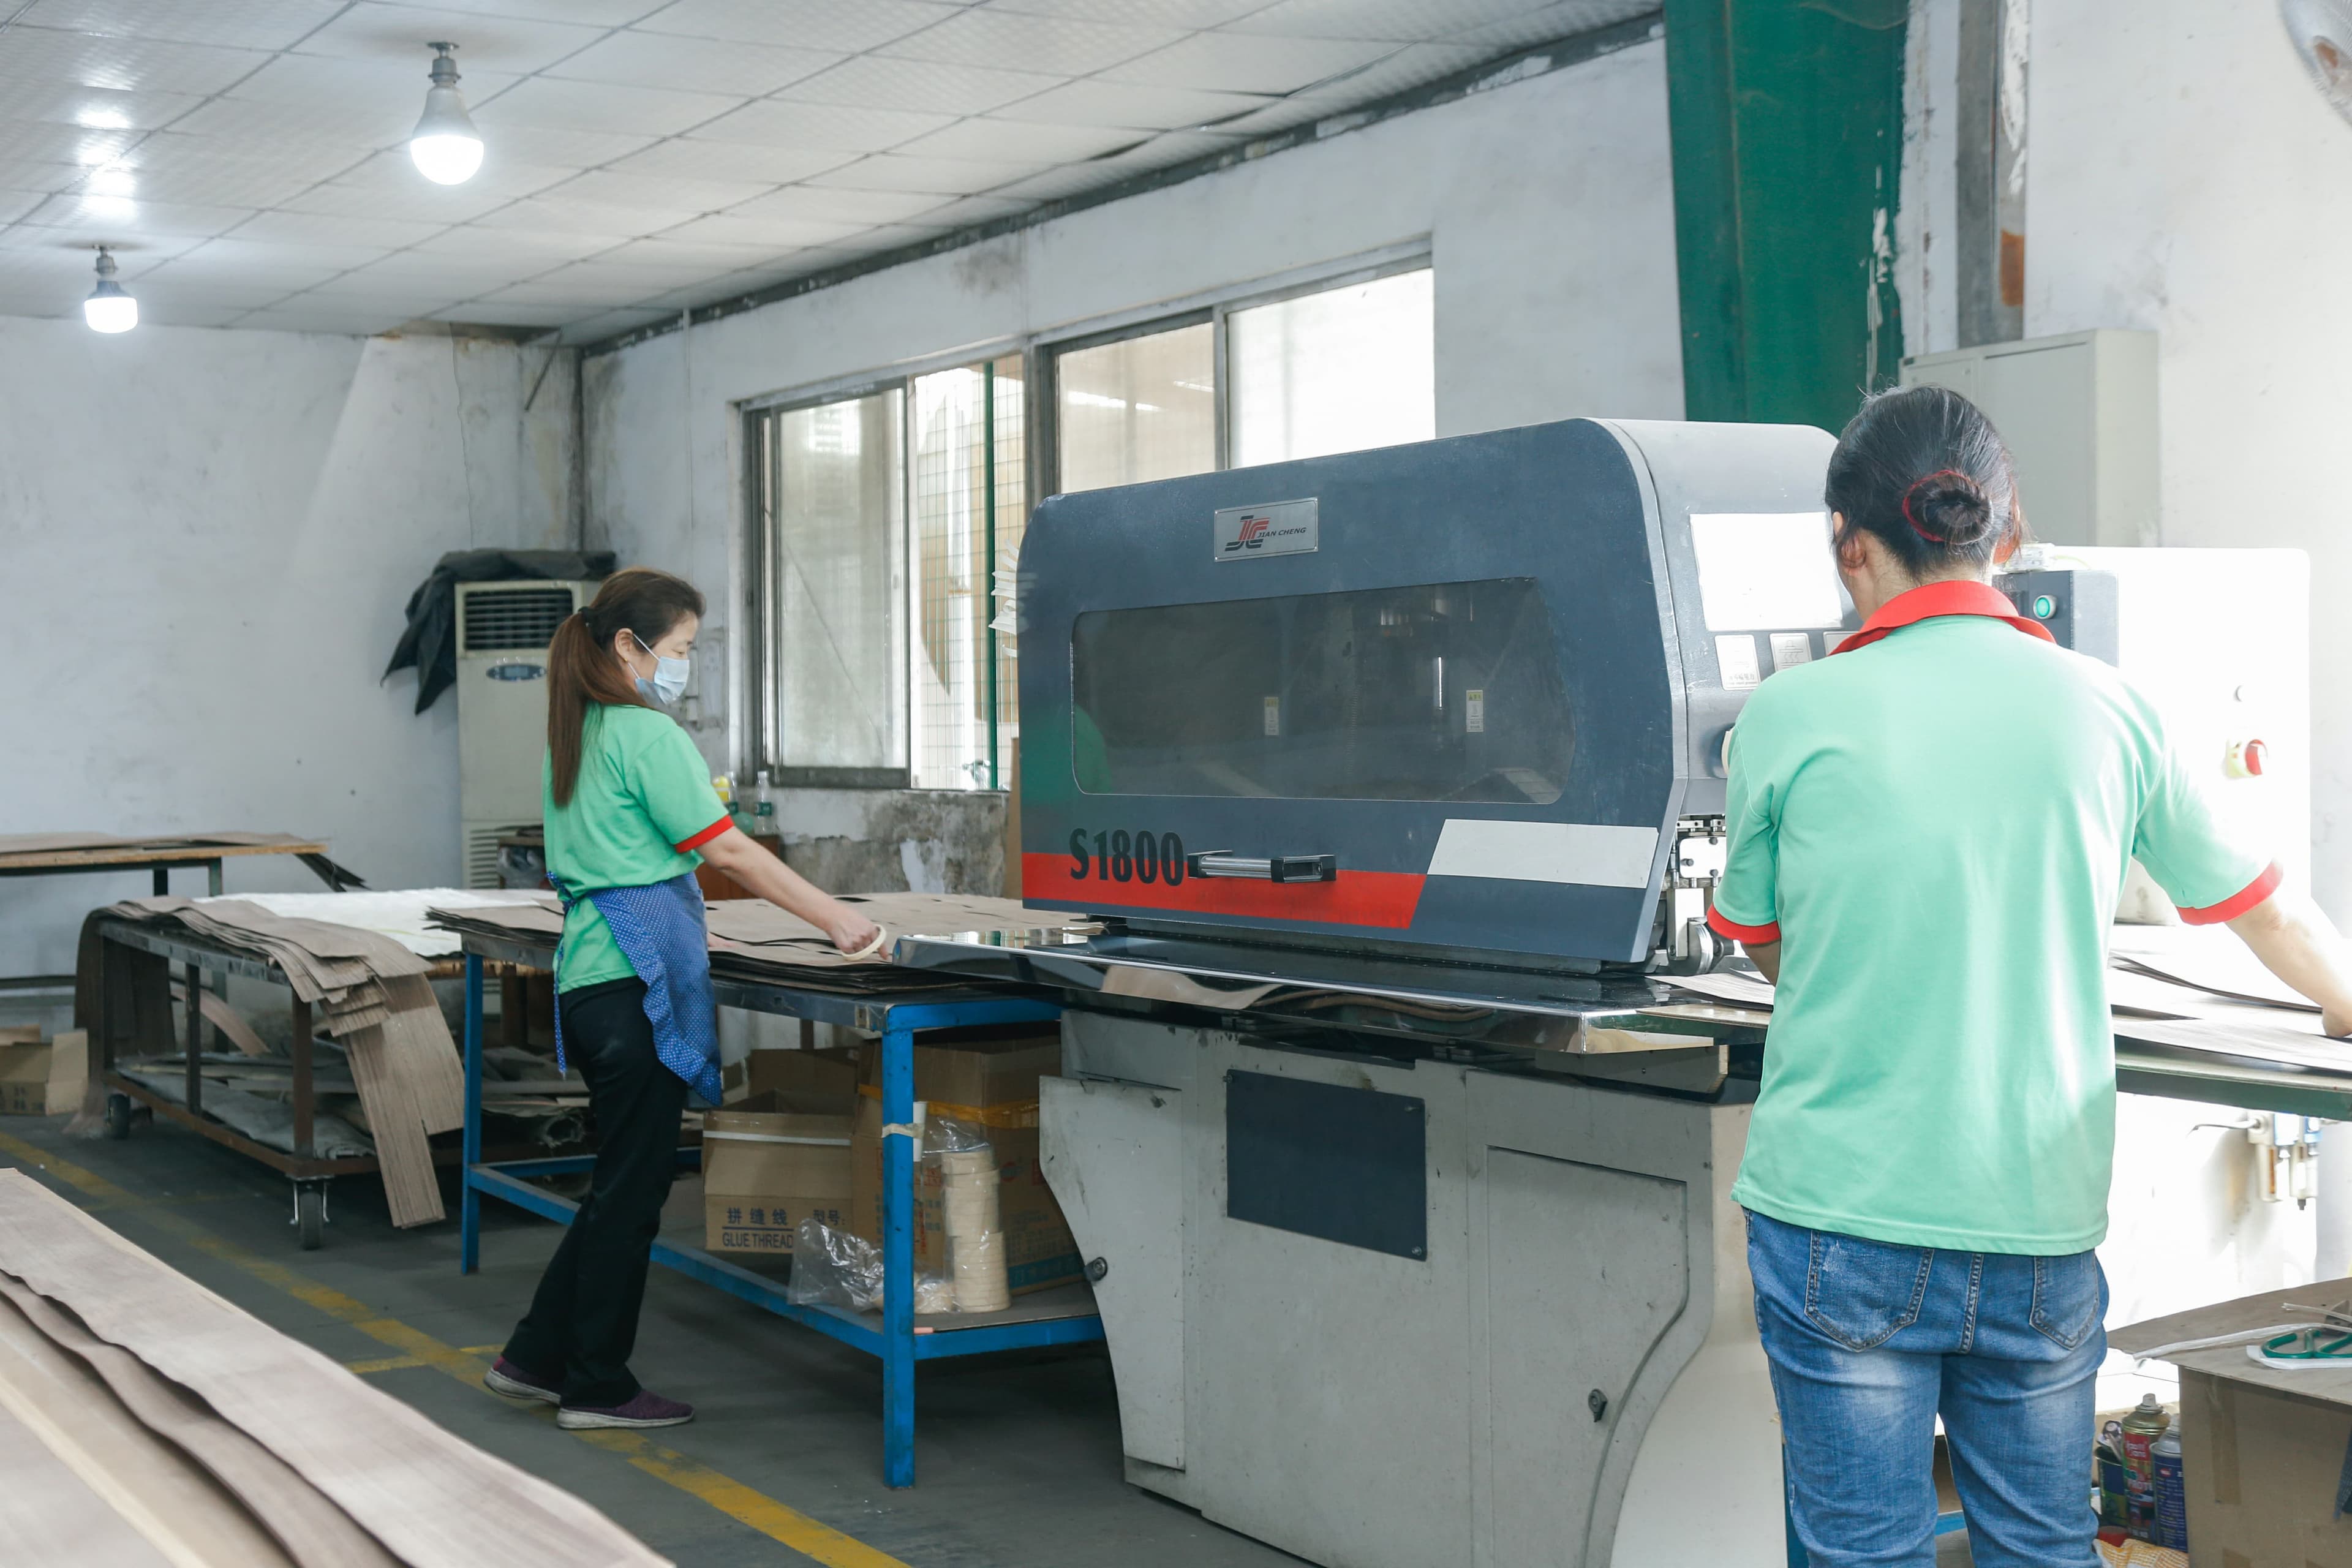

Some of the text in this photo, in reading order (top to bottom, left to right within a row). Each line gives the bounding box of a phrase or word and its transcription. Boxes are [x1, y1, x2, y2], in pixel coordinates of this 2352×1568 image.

[1069, 827, 1184, 886] S1800
[726, 1207, 788, 1225] 拼缝线
[722, 1232, 794, 1248] GLUE THREAD
